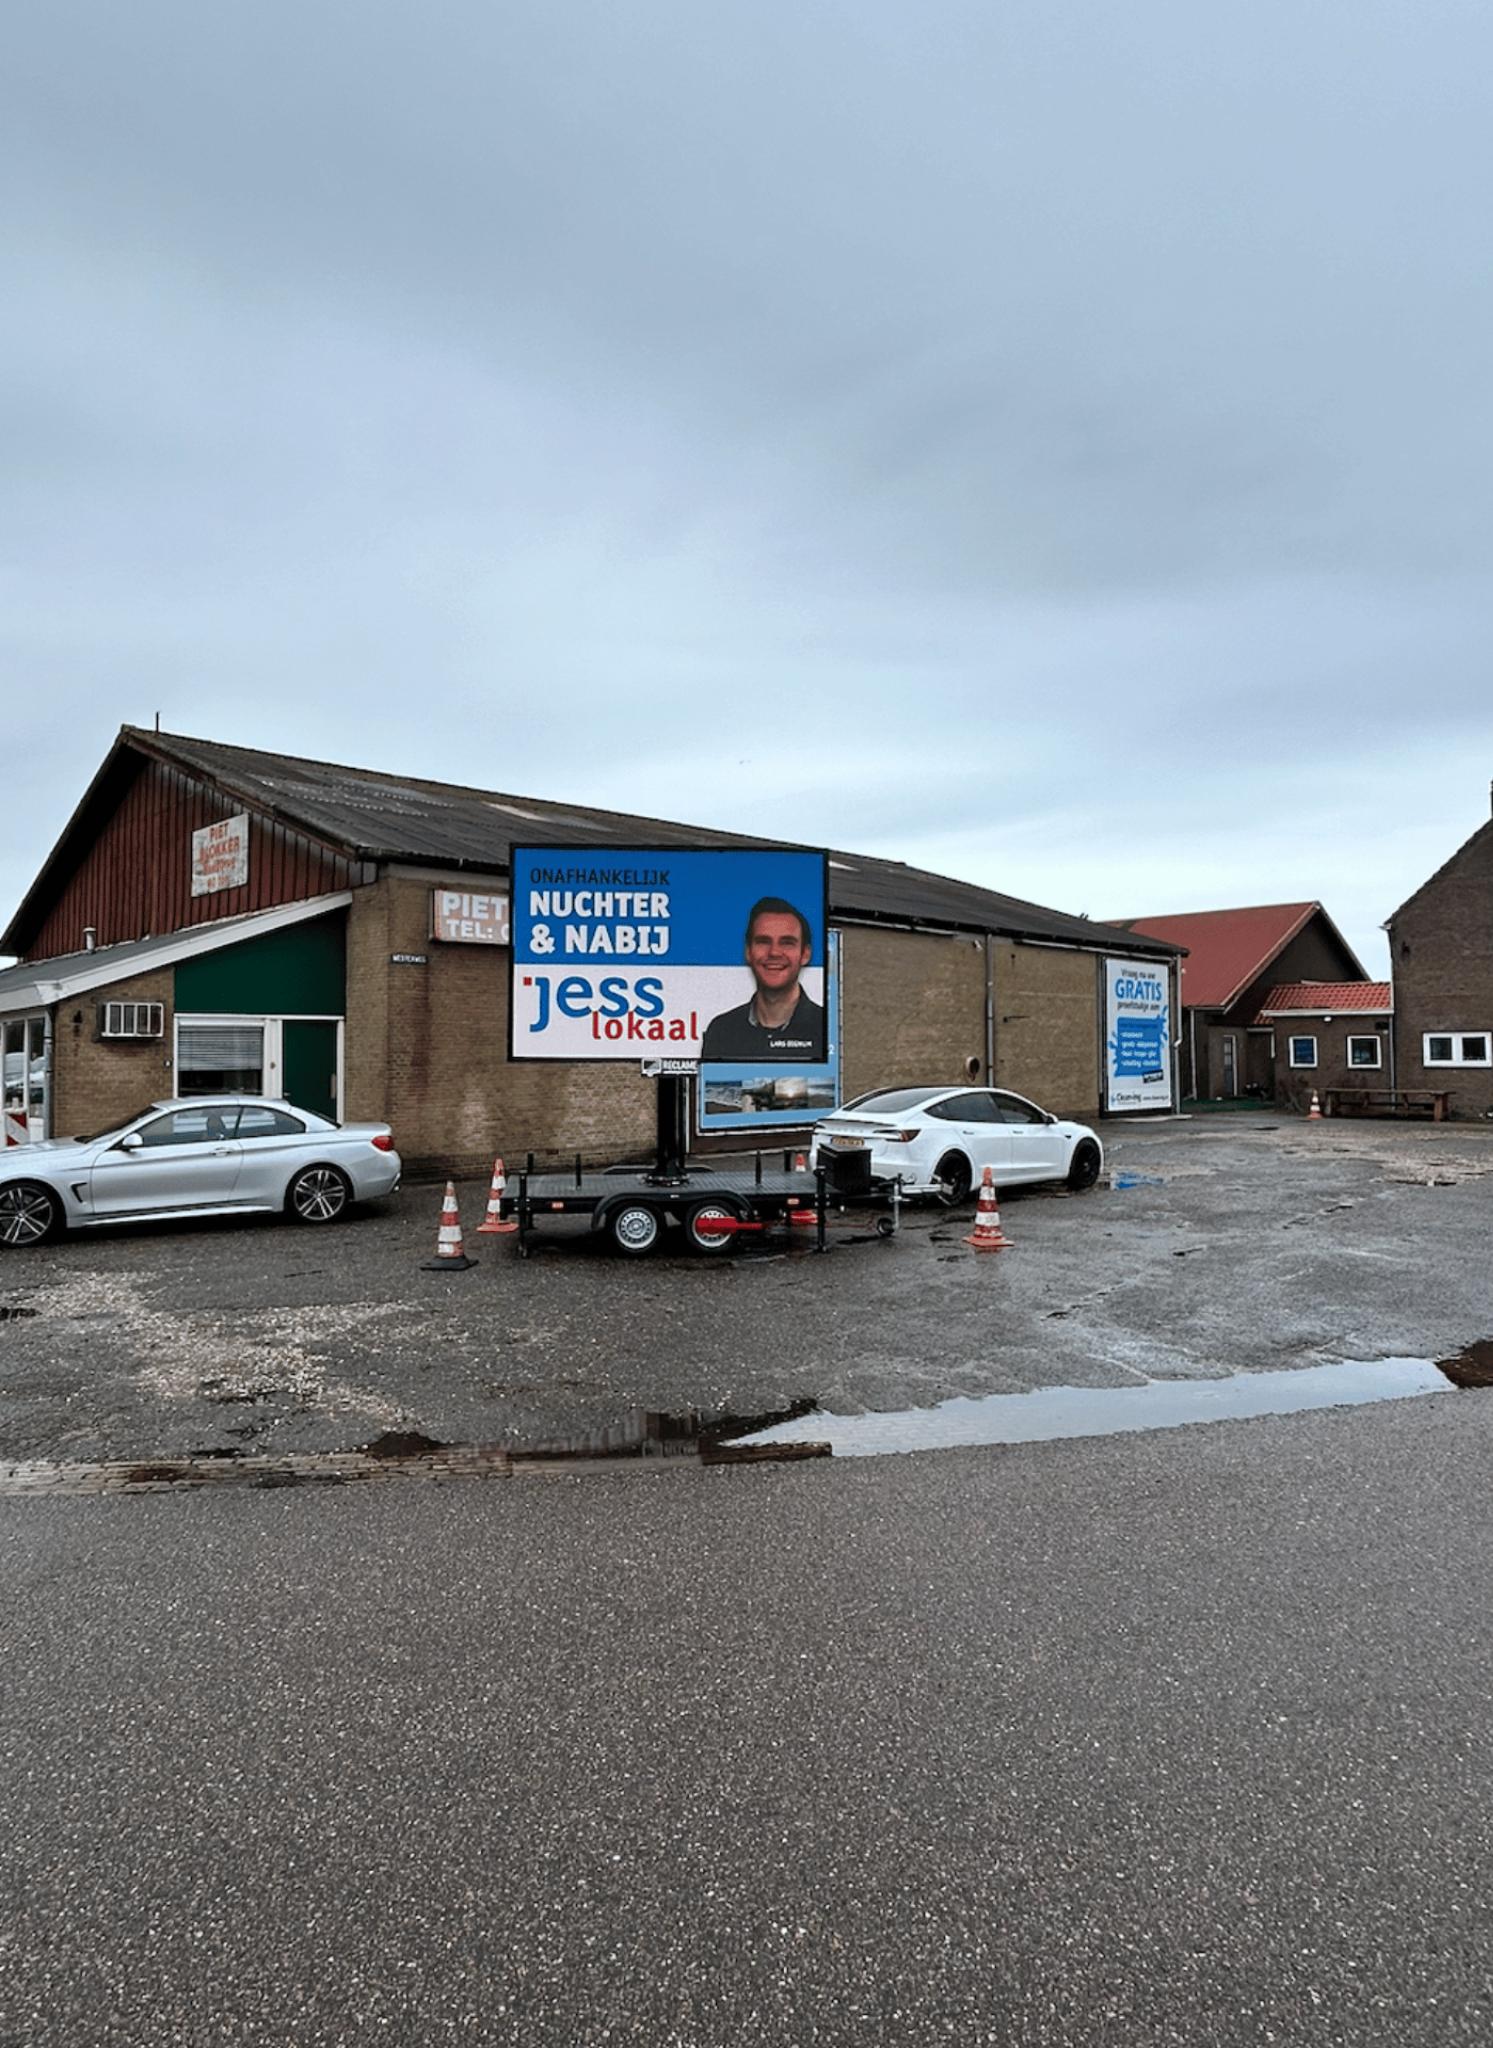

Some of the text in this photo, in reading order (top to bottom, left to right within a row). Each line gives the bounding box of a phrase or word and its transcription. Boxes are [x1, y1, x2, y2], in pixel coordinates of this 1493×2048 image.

[530, 868, 670, 885] ONAFHANKELIJK
[443, 891, 509, 921] PIET
[530, 891, 670, 918] NUCHTER
[446, 920, 493, 939] TEL:
[530, 924, 670, 955] & NABIJ
[1115, 978, 1162, 1001] GRATIS
[523, 976, 664, 1032] jess
[592, 1011, 699, 1040] lokaal
